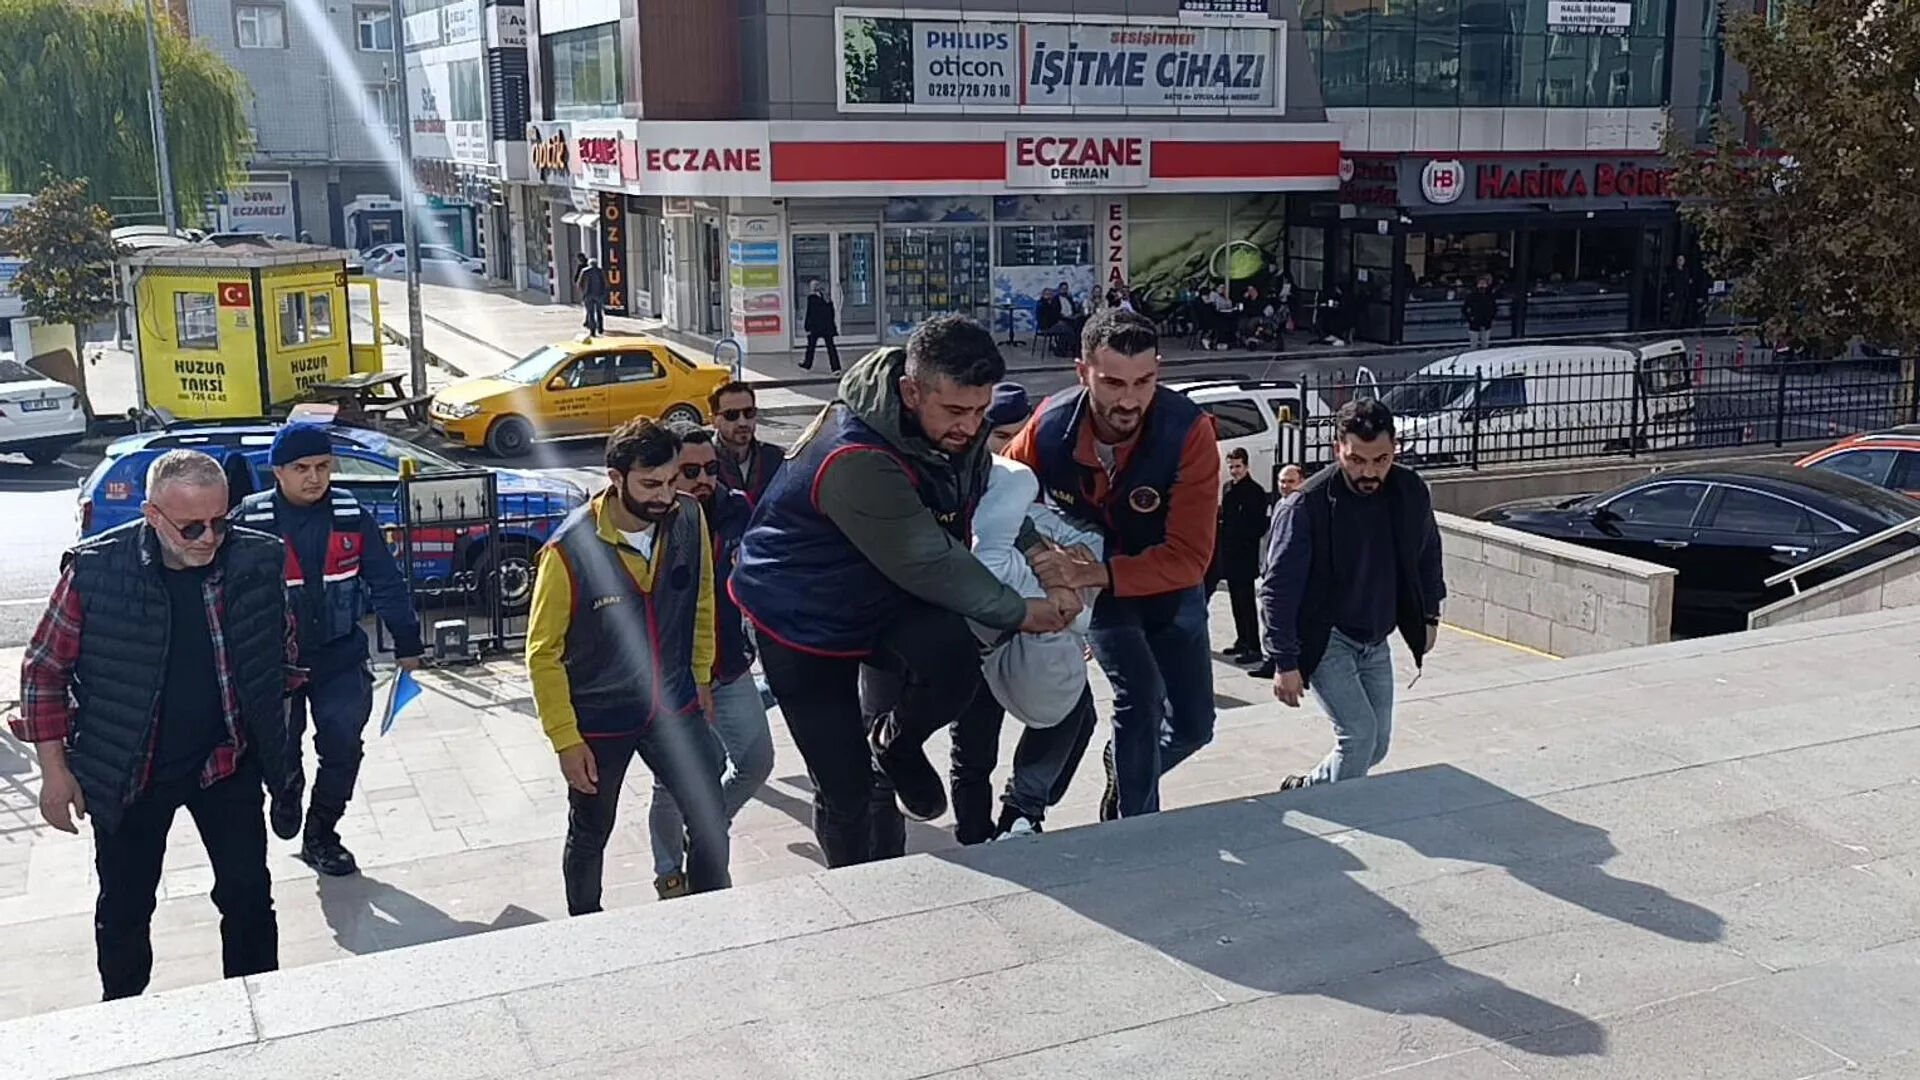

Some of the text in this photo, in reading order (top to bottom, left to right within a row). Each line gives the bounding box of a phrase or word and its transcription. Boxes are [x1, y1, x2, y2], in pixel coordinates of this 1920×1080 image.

[927, 31, 1008, 50] PHILIPS
[929, 55, 1004, 77] oticon
[1030, 41, 1265, 94] İŞİTME CİHAZI
[928, 83, 956, 97] 0282
[1000, 84, 1011, 97] 10
[646, 149, 761, 171] ECZANE
[1016, 137, 1142, 166] ECZANE
[1051, 167, 1109, 179] DERMAN
[174, 360, 225, 375] HUZUR
[290, 355, 328, 374] HUZUR
[181, 375, 223, 392] TAKSİ
[110, 483, 126, 493] 112
